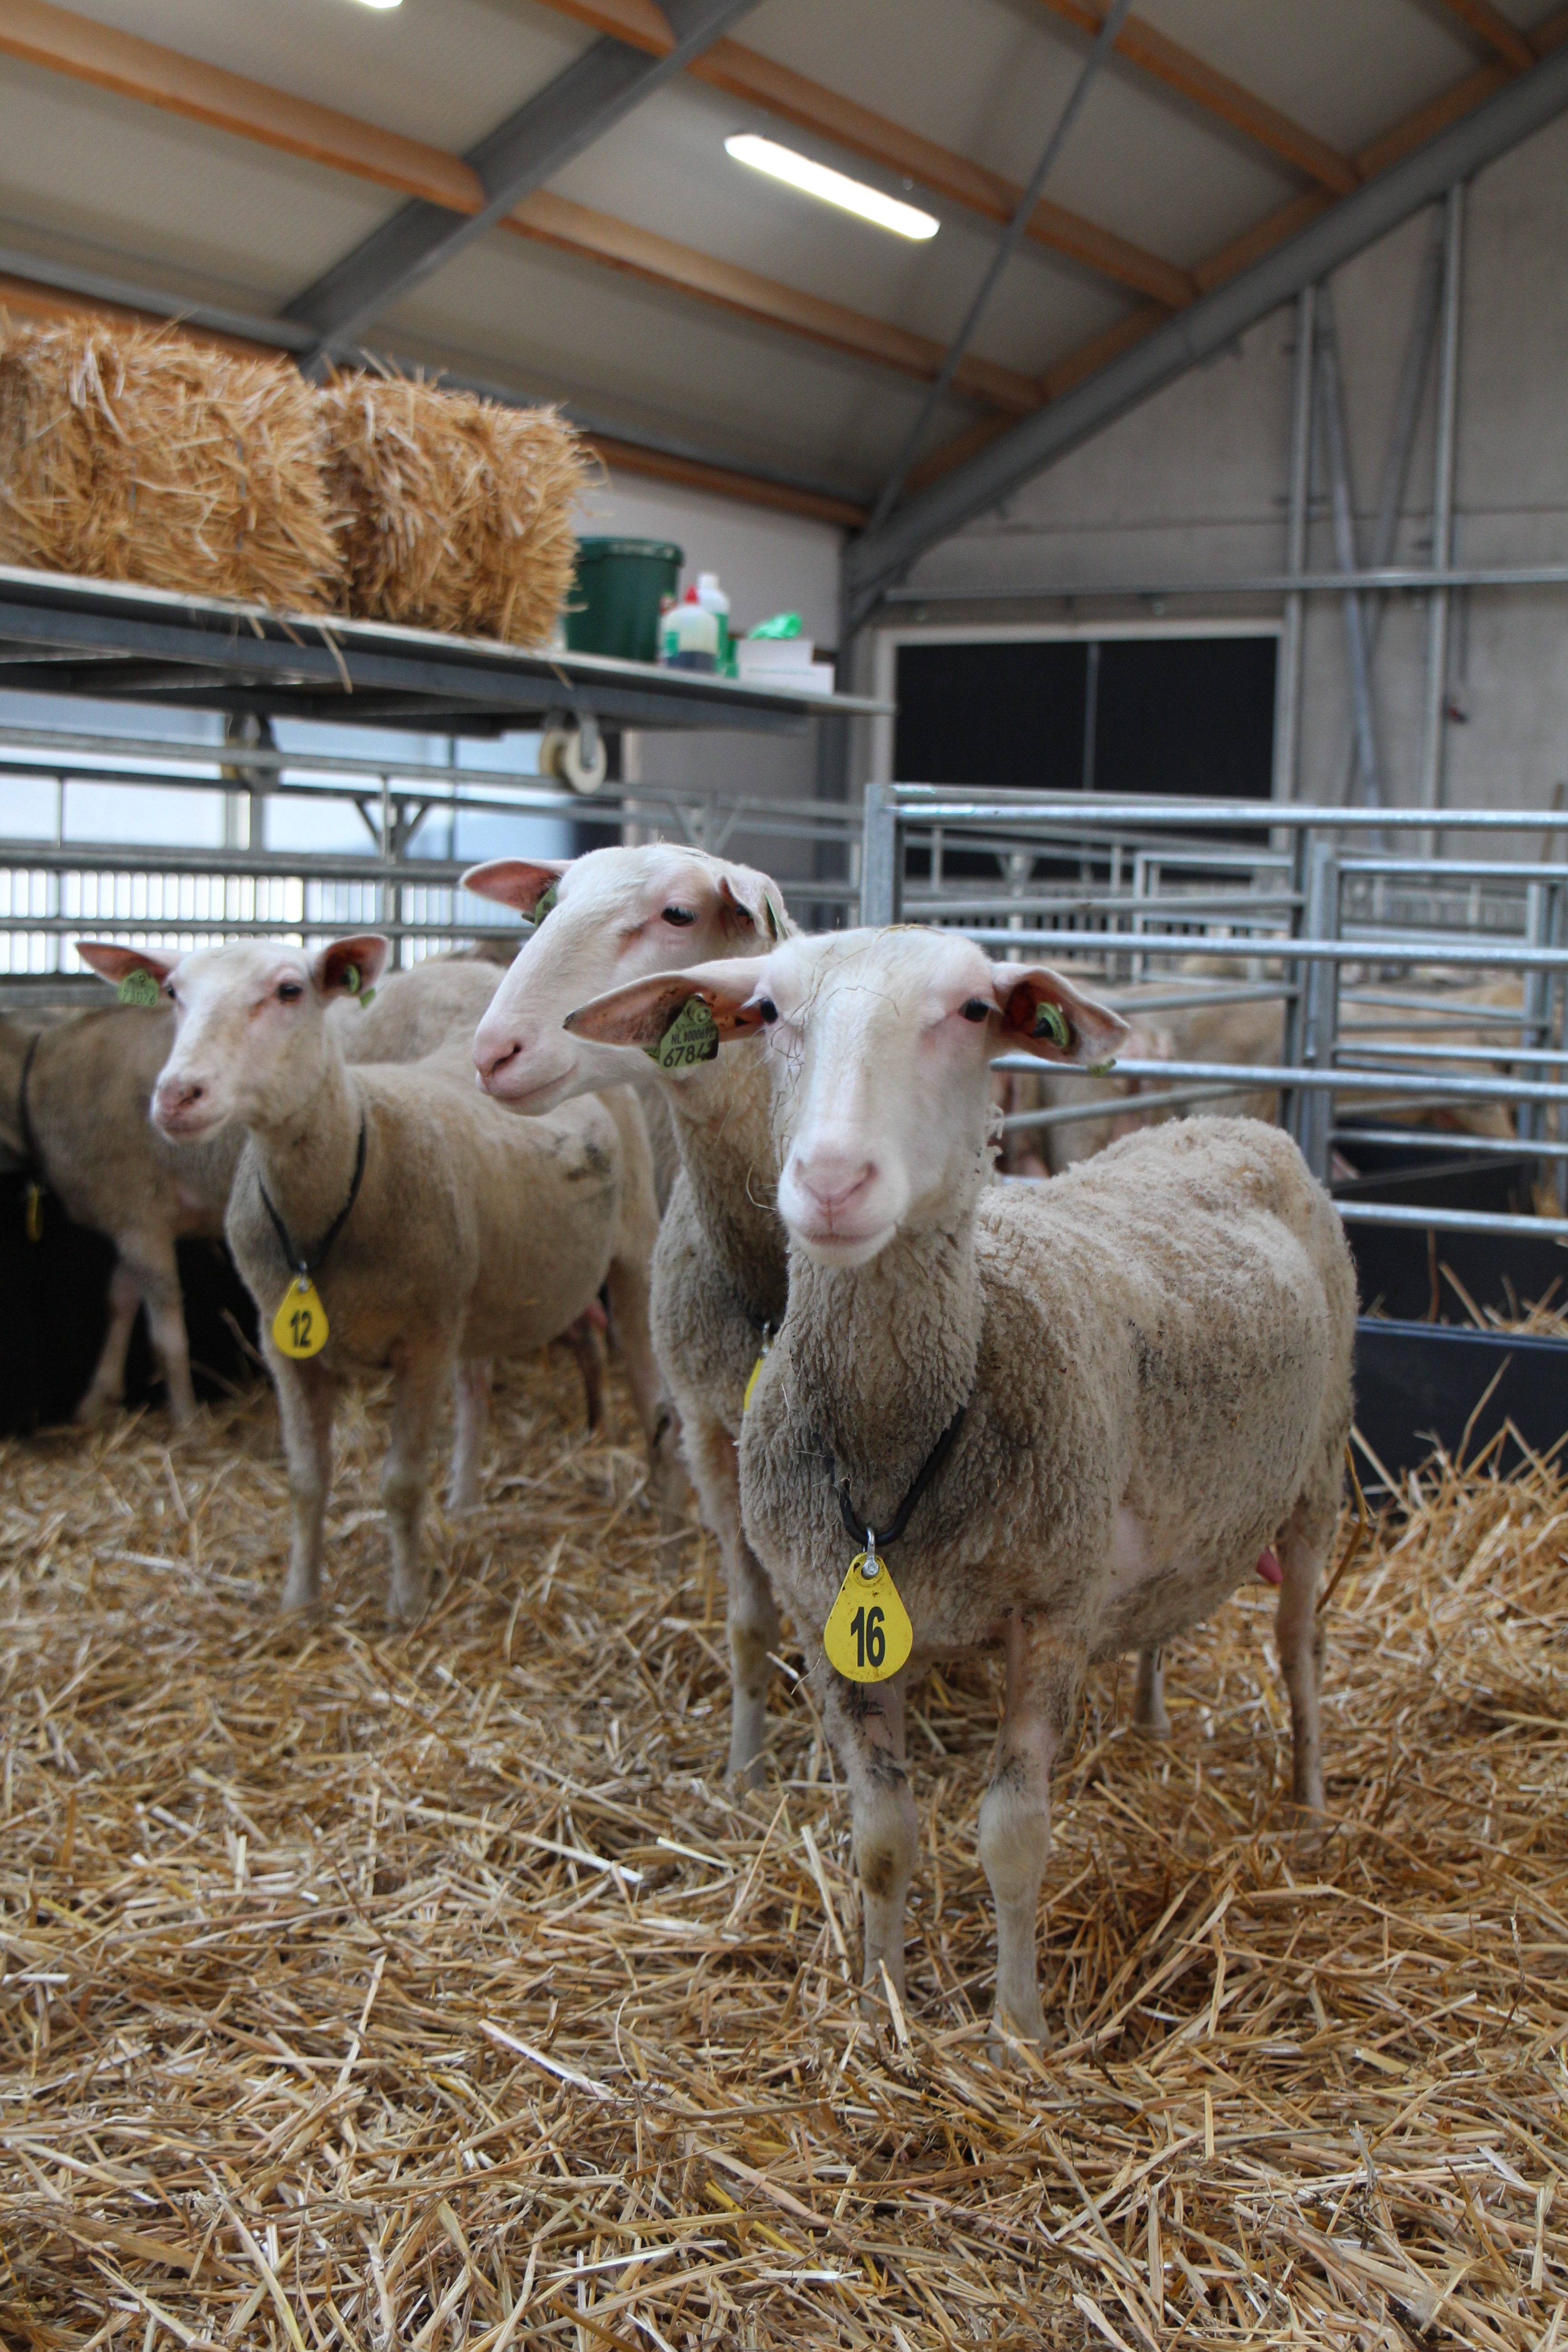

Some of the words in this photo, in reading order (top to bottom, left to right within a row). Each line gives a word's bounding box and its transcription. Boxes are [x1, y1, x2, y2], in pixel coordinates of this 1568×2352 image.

[671, 1033, 682, 1045] NL
[290, 1310, 313, 1348] 12
[850, 1606, 885, 1667] 16
